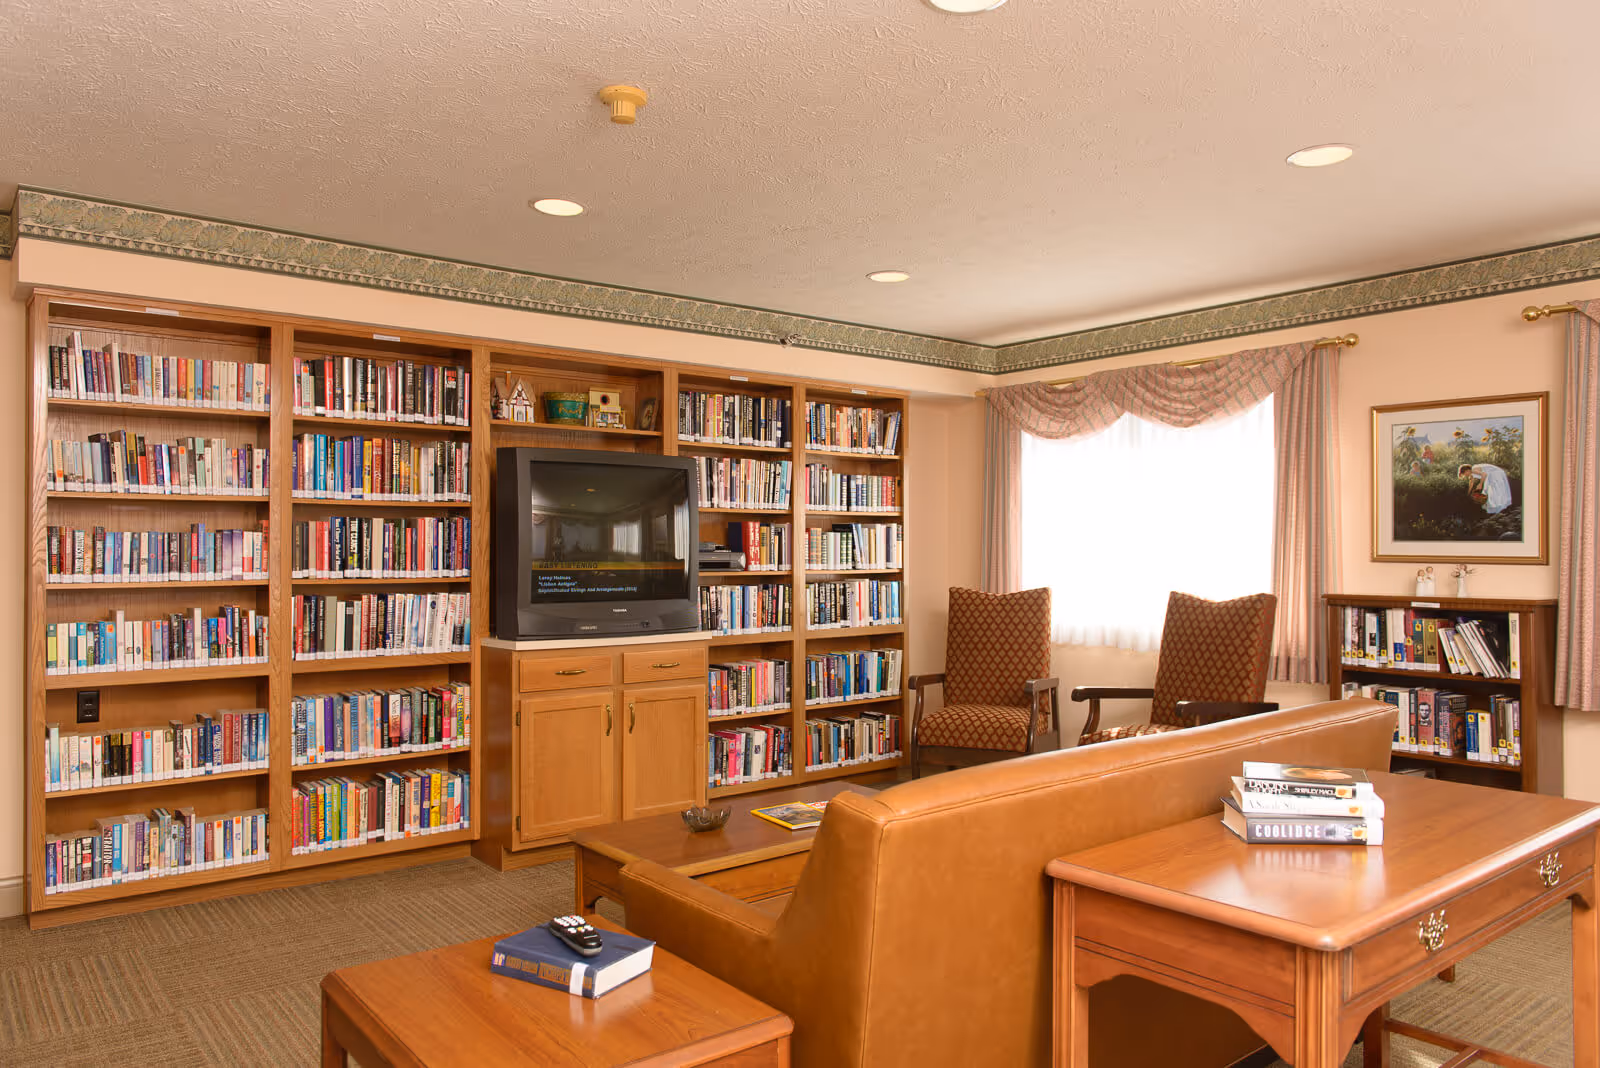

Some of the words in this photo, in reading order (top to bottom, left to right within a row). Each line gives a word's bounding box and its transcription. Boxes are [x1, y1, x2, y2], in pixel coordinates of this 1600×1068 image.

[406, 393, 414, 410] SPY
[349, 533, 357, 553] CLANCY
[1255, 824, 1321, 839] COOLIDGE
[103, 837, 112, 864] TRAITOR
